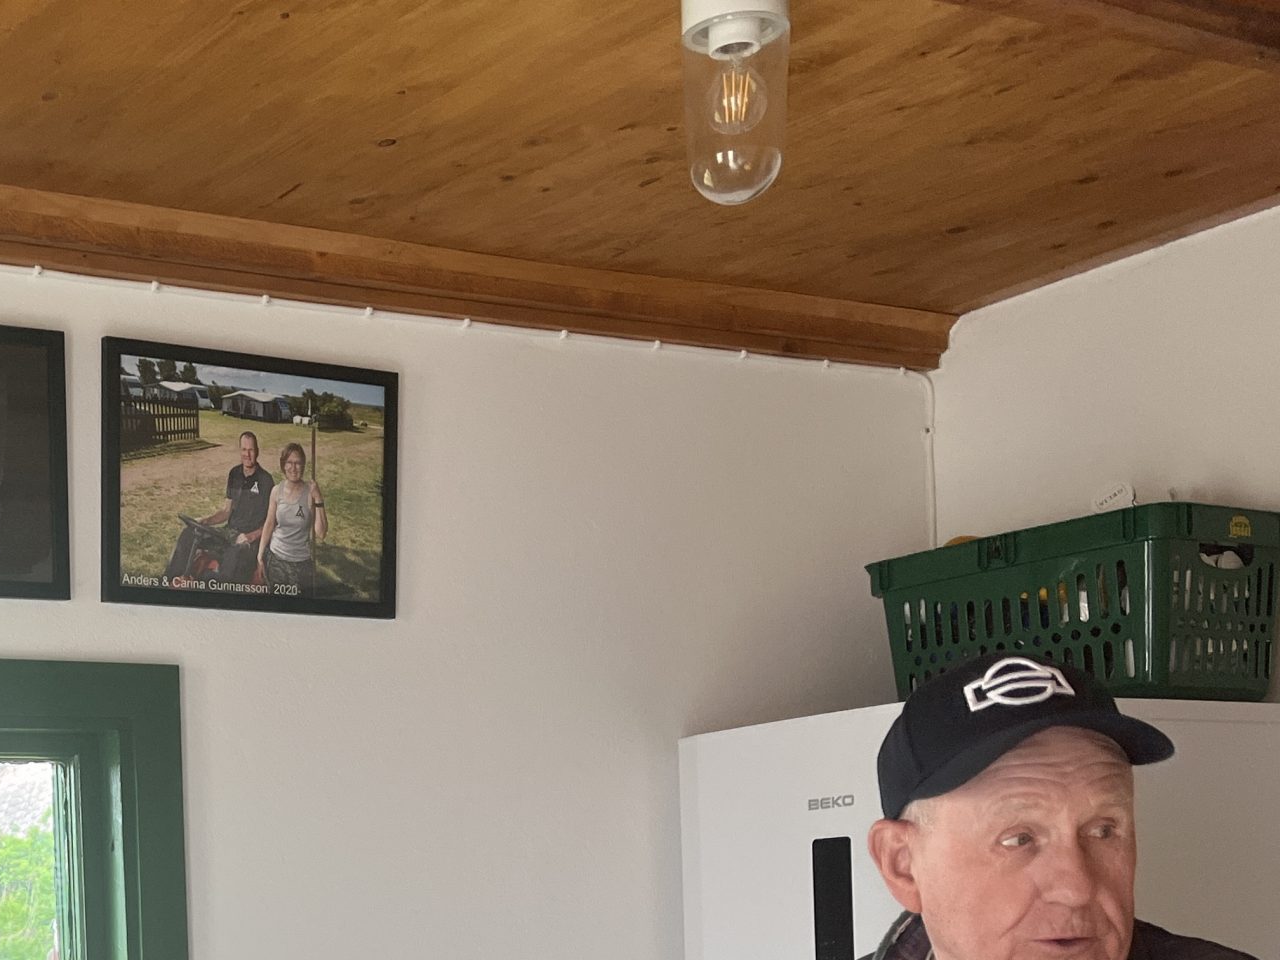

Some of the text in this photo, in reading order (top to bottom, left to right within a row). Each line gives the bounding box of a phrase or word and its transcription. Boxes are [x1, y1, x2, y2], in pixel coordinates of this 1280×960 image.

[122, 573, 159, 587] Anders
[161, 576, 170, 588] &
[172, 577, 206, 590] Carina
[808, 794, 855, 811] BEKO
